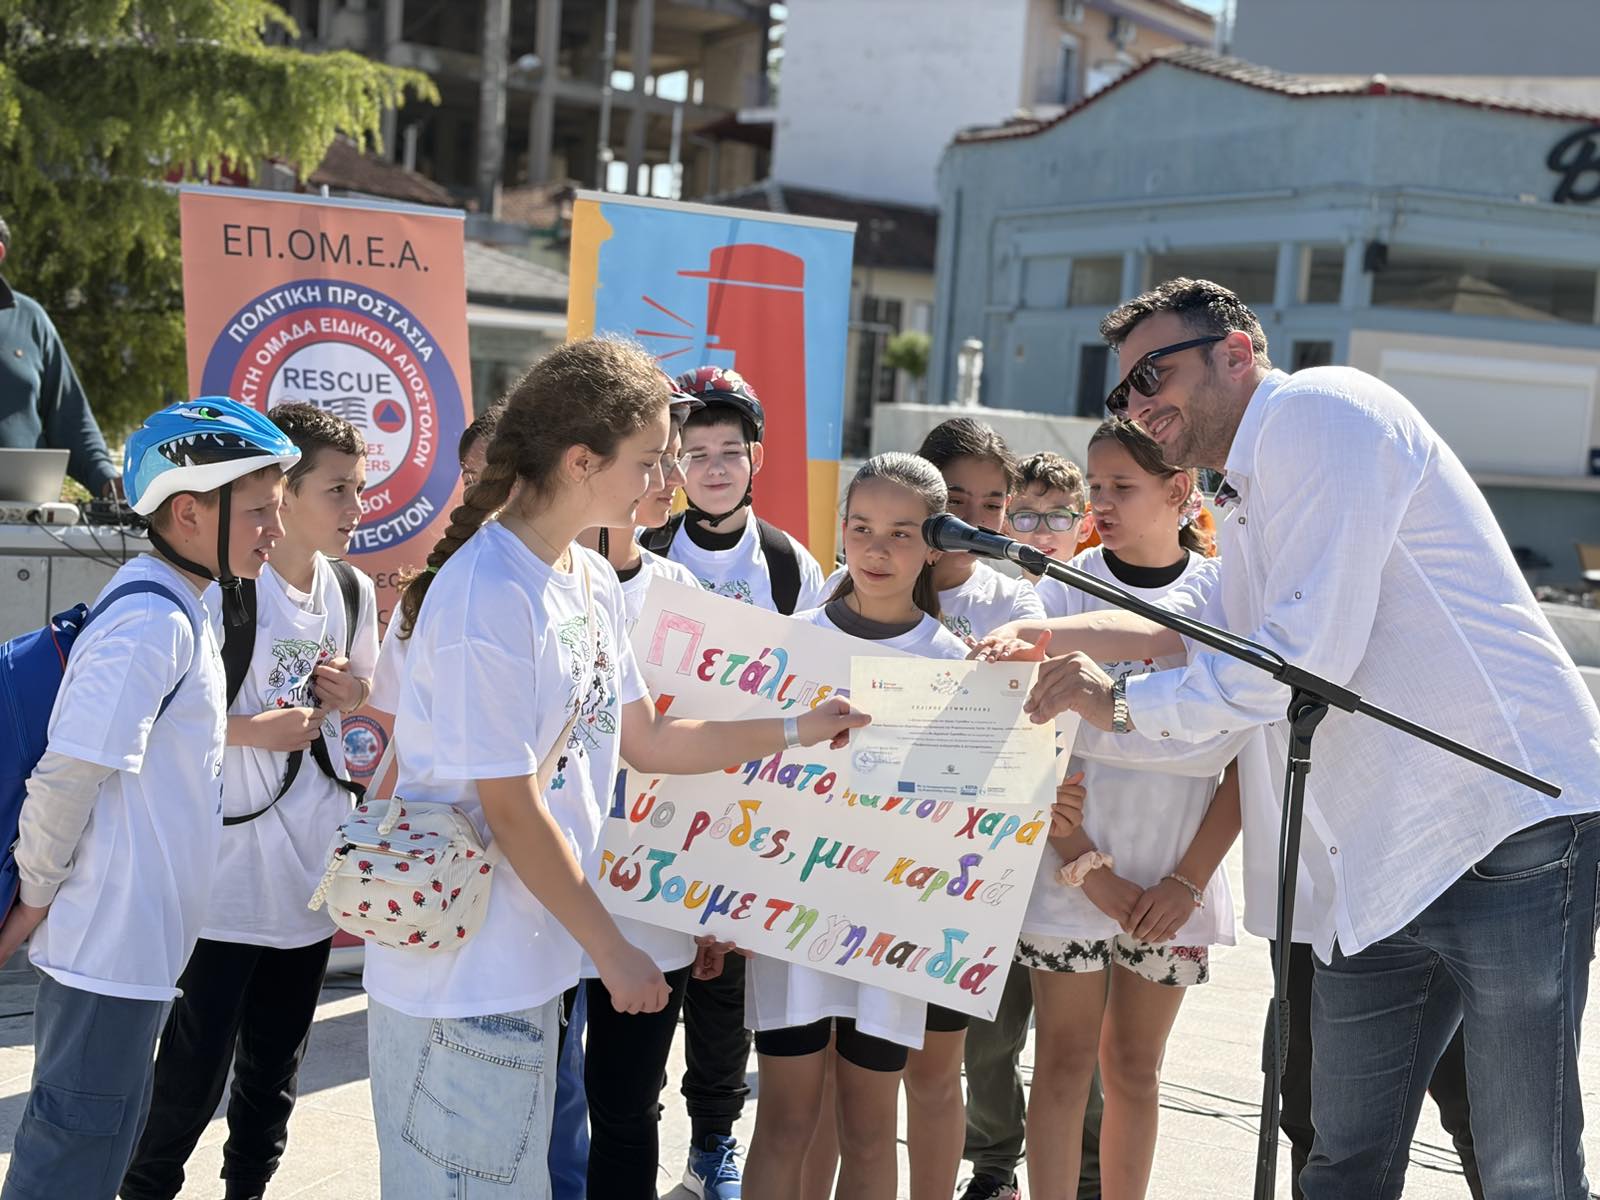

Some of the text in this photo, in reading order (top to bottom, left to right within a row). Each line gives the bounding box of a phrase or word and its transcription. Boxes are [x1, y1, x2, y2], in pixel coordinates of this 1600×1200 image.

[223, 223, 429, 272] ΕΠ.ΟΜ.Ε.Α.
[228, 286, 433, 362] ΠΟΛΙΤΙΚΗ ΠΡΟΣΤΑΣΙΑ
[256, 320, 316, 366] ΟΜΑΔΑ
[320, 317, 397, 355] ΕΙΔΙΚΩΝ
[393, 354, 432, 468] ΑΠΟΣΤΟΛΩΝ
[283, 368, 392, 394] RESCUE
[352, 496, 434, 549] TECTION
[682, 800, 796, 864] ρόδες,
[799, 836, 880, 882] μια
[883, 853, 1015, 906] καρδιά
[954, 806, 1045, 850] χαρά
[763, 899, 819, 951] τη
